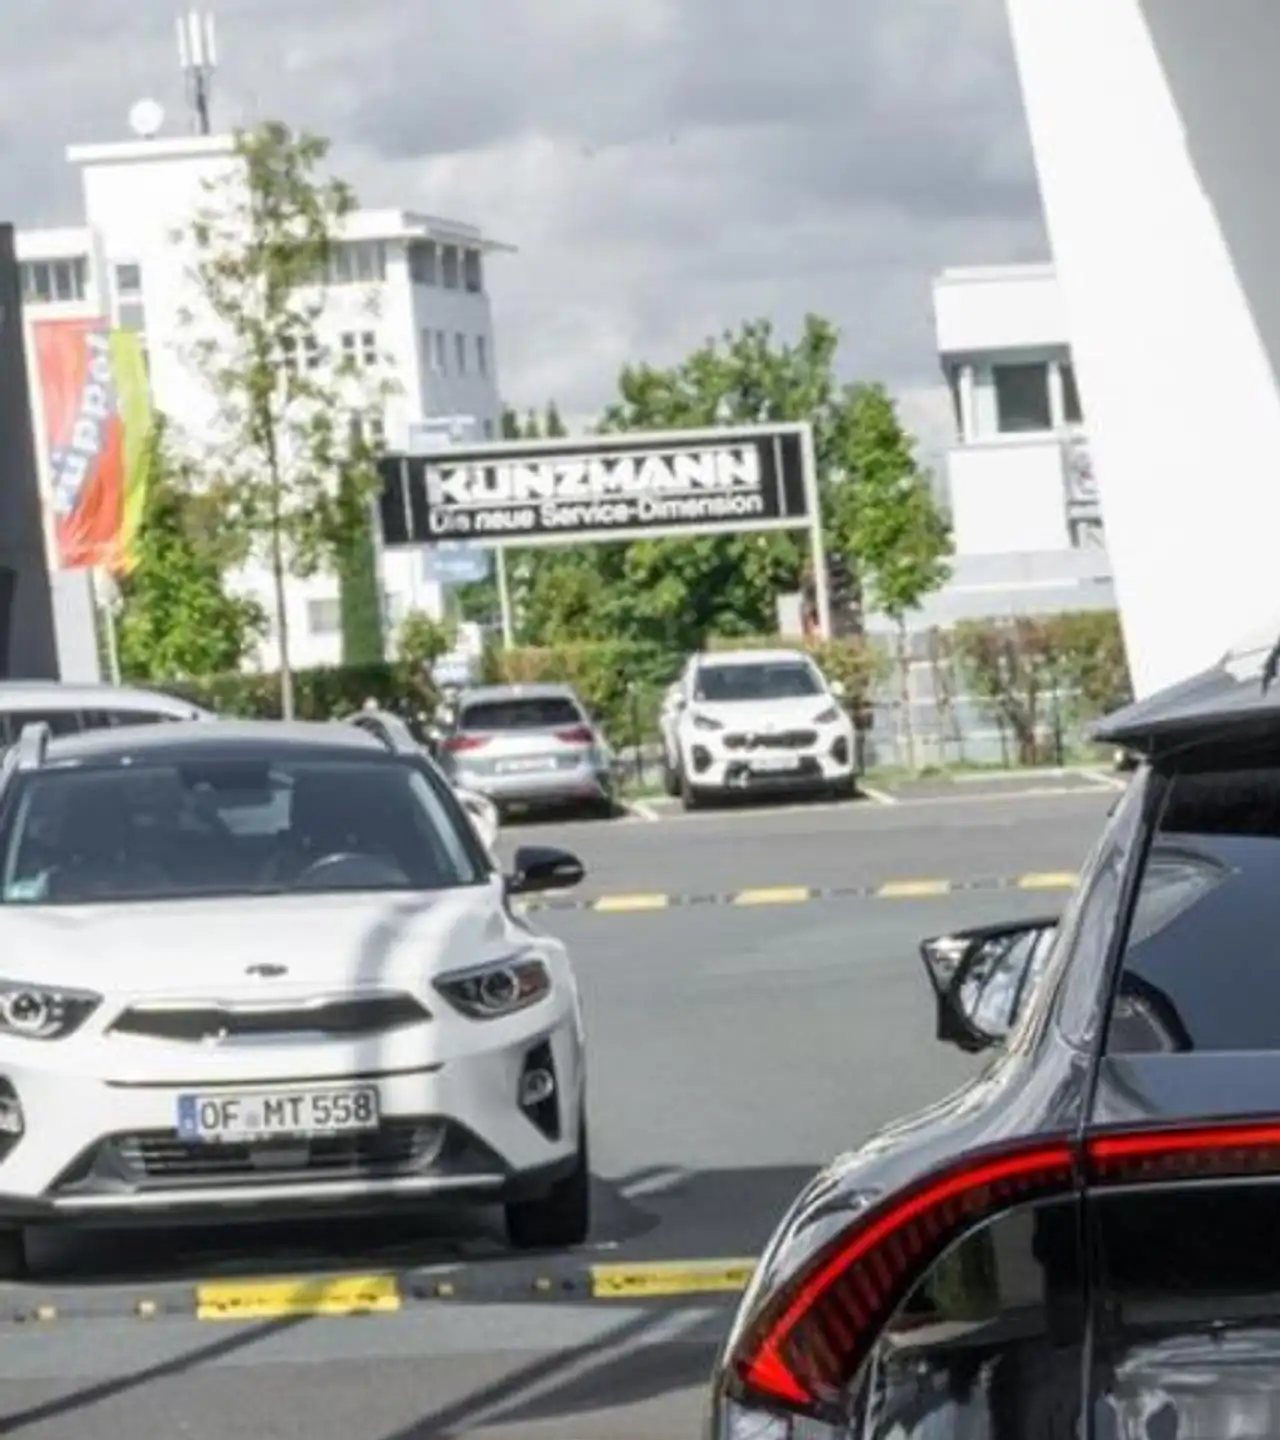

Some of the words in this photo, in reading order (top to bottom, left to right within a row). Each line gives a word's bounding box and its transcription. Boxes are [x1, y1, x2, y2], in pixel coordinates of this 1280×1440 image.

[425, 445, 760, 507] KUNZMANN
[474, 508, 534, 532] neue
[540, 489, 764, 528] Service-Dimension
[201, 1101, 240, 1129] OF
[264, 1097, 304, 1126] MT
[312, 1092, 372, 1124] 558
